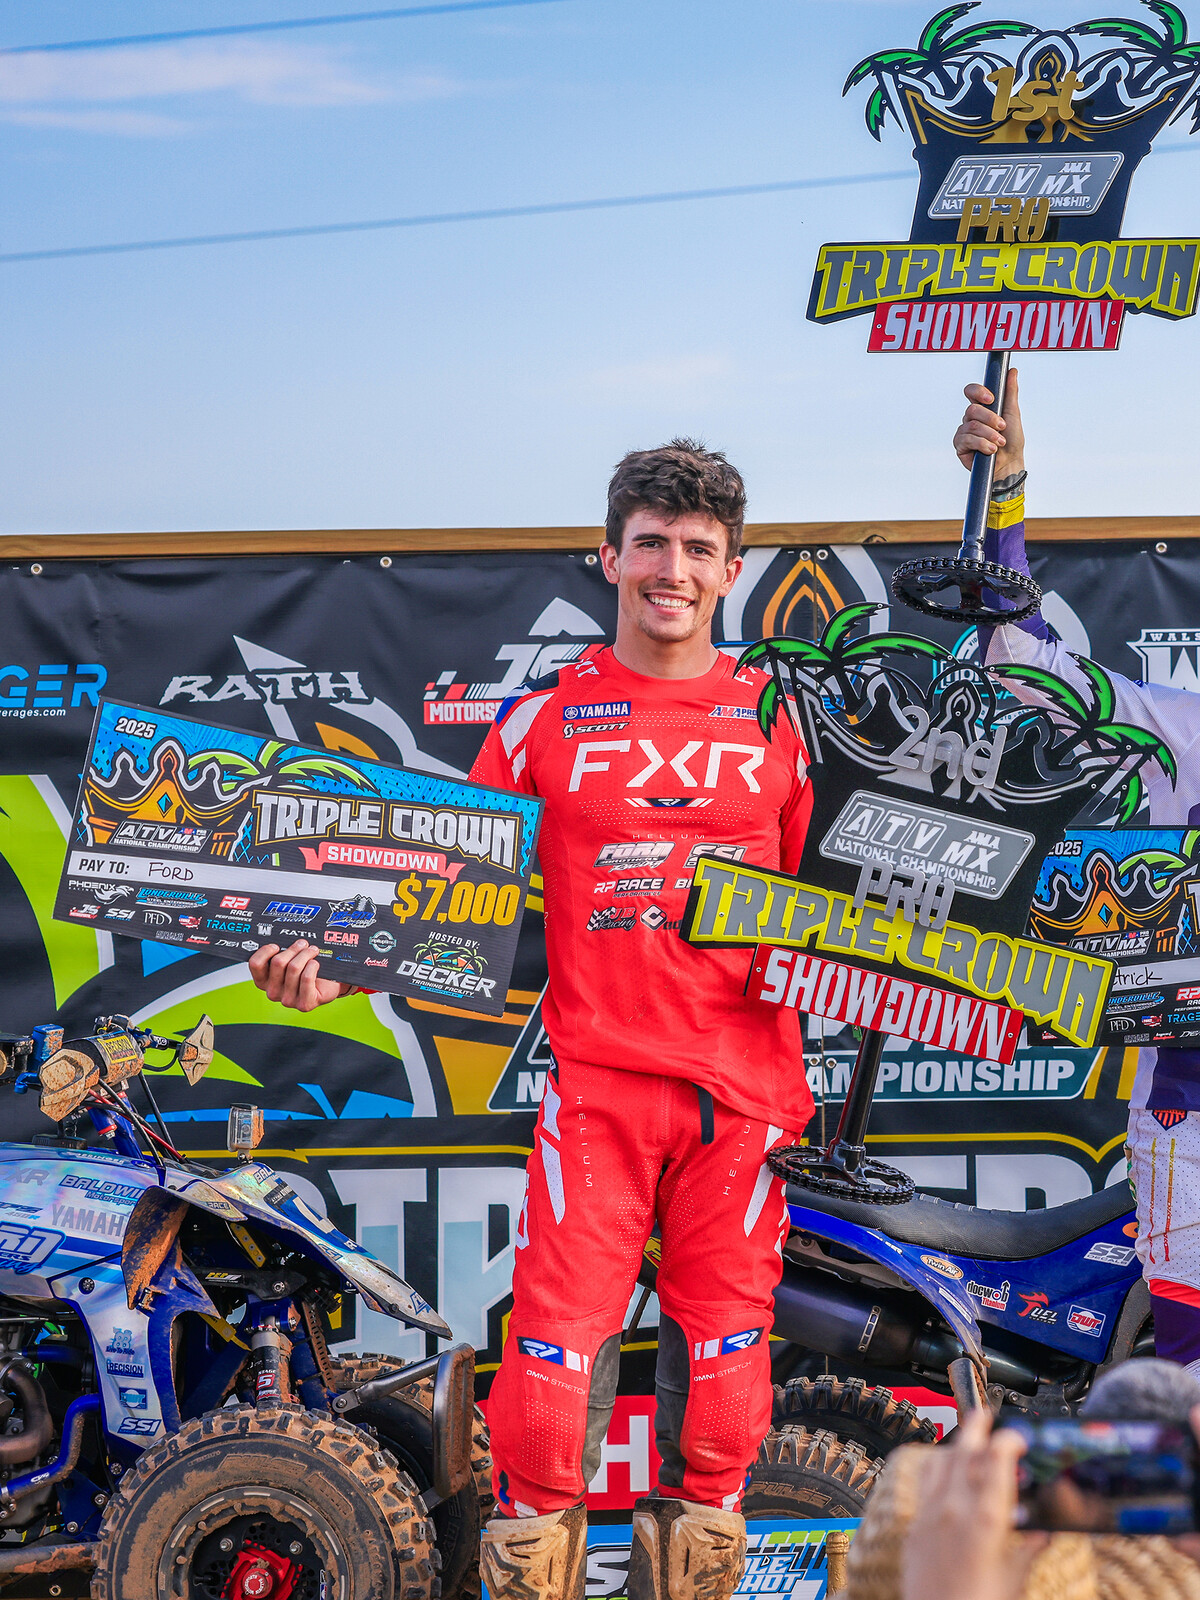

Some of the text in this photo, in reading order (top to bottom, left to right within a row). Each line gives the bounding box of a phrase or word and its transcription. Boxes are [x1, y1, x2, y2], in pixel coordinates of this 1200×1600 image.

[986, 66, 1084, 121] 1st
[950, 168, 1092, 195] ATV MX
[956, 198, 1051, 242] PRO
[820, 244, 1198, 312] TRIPLE CROWN
[881, 302, 1113, 350] SHOWDOWN
[159, 671, 369, 706] RATH
[579, 703, 629, 717] YAMAHA
[710, 706, 742, 717] AMA
[115, 717, 157, 739] 2025
[575, 723, 629, 734] SCOTT
[888, 704, 1008, 790] 2nd
[568, 739, 766, 794] FXR
[117, 823, 207, 845] ATV MX
[256, 793, 518, 870] TRIPLE CROWN
[844, 807, 1001, 874] ATV MX
[114, 838, 200, 853] NATIONAL CHAMPIONSHIP
[78, 858, 130, 875] PAY TO:
[327, 846, 439, 871] SHOWDOWN
[834, 837, 997, 889] NATIONAL CHAMPIONSHIP
[68, 879, 116, 892] PHOENIX
[594, 878, 664, 894] RP RACE
[852, 857, 957, 931] PRO
[222, 896, 249, 909] RP
[392, 872, 522, 926] $7,000
[105, 908, 136, 919] SSI
[214, 914, 253, 922] PERFORMANCE
[229, 909, 254, 917] RACE
[612, 907, 638, 919] JB
[206, 919, 252, 933] TRAGER
[279, 928, 317, 939] RATH
[324, 930, 360, 945] GEAR
[428, 931, 481, 949] HOSTED BY:
[1117, 937, 1150, 950] MX
[697, 865, 1107, 1042] TRIPLE CROWN
[396, 959, 498, 999] DECKER
[411, 978, 475, 998] TRAINING FACILITY
[759, 948, 1012, 1062] SHOWDOWN
[576, 1095, 594, 1188] HELIUM
[51, 1203, 125, 1237] YAMAH
[1089, 1243, 1137, 1263] SSI
[926, 1258, 959, 1277] Twin Air
[981, 1297, 1006, 1311] Titanium
[258, 1374, 274, 1389] 5
[121, 1418, 162, 1432] SSI
